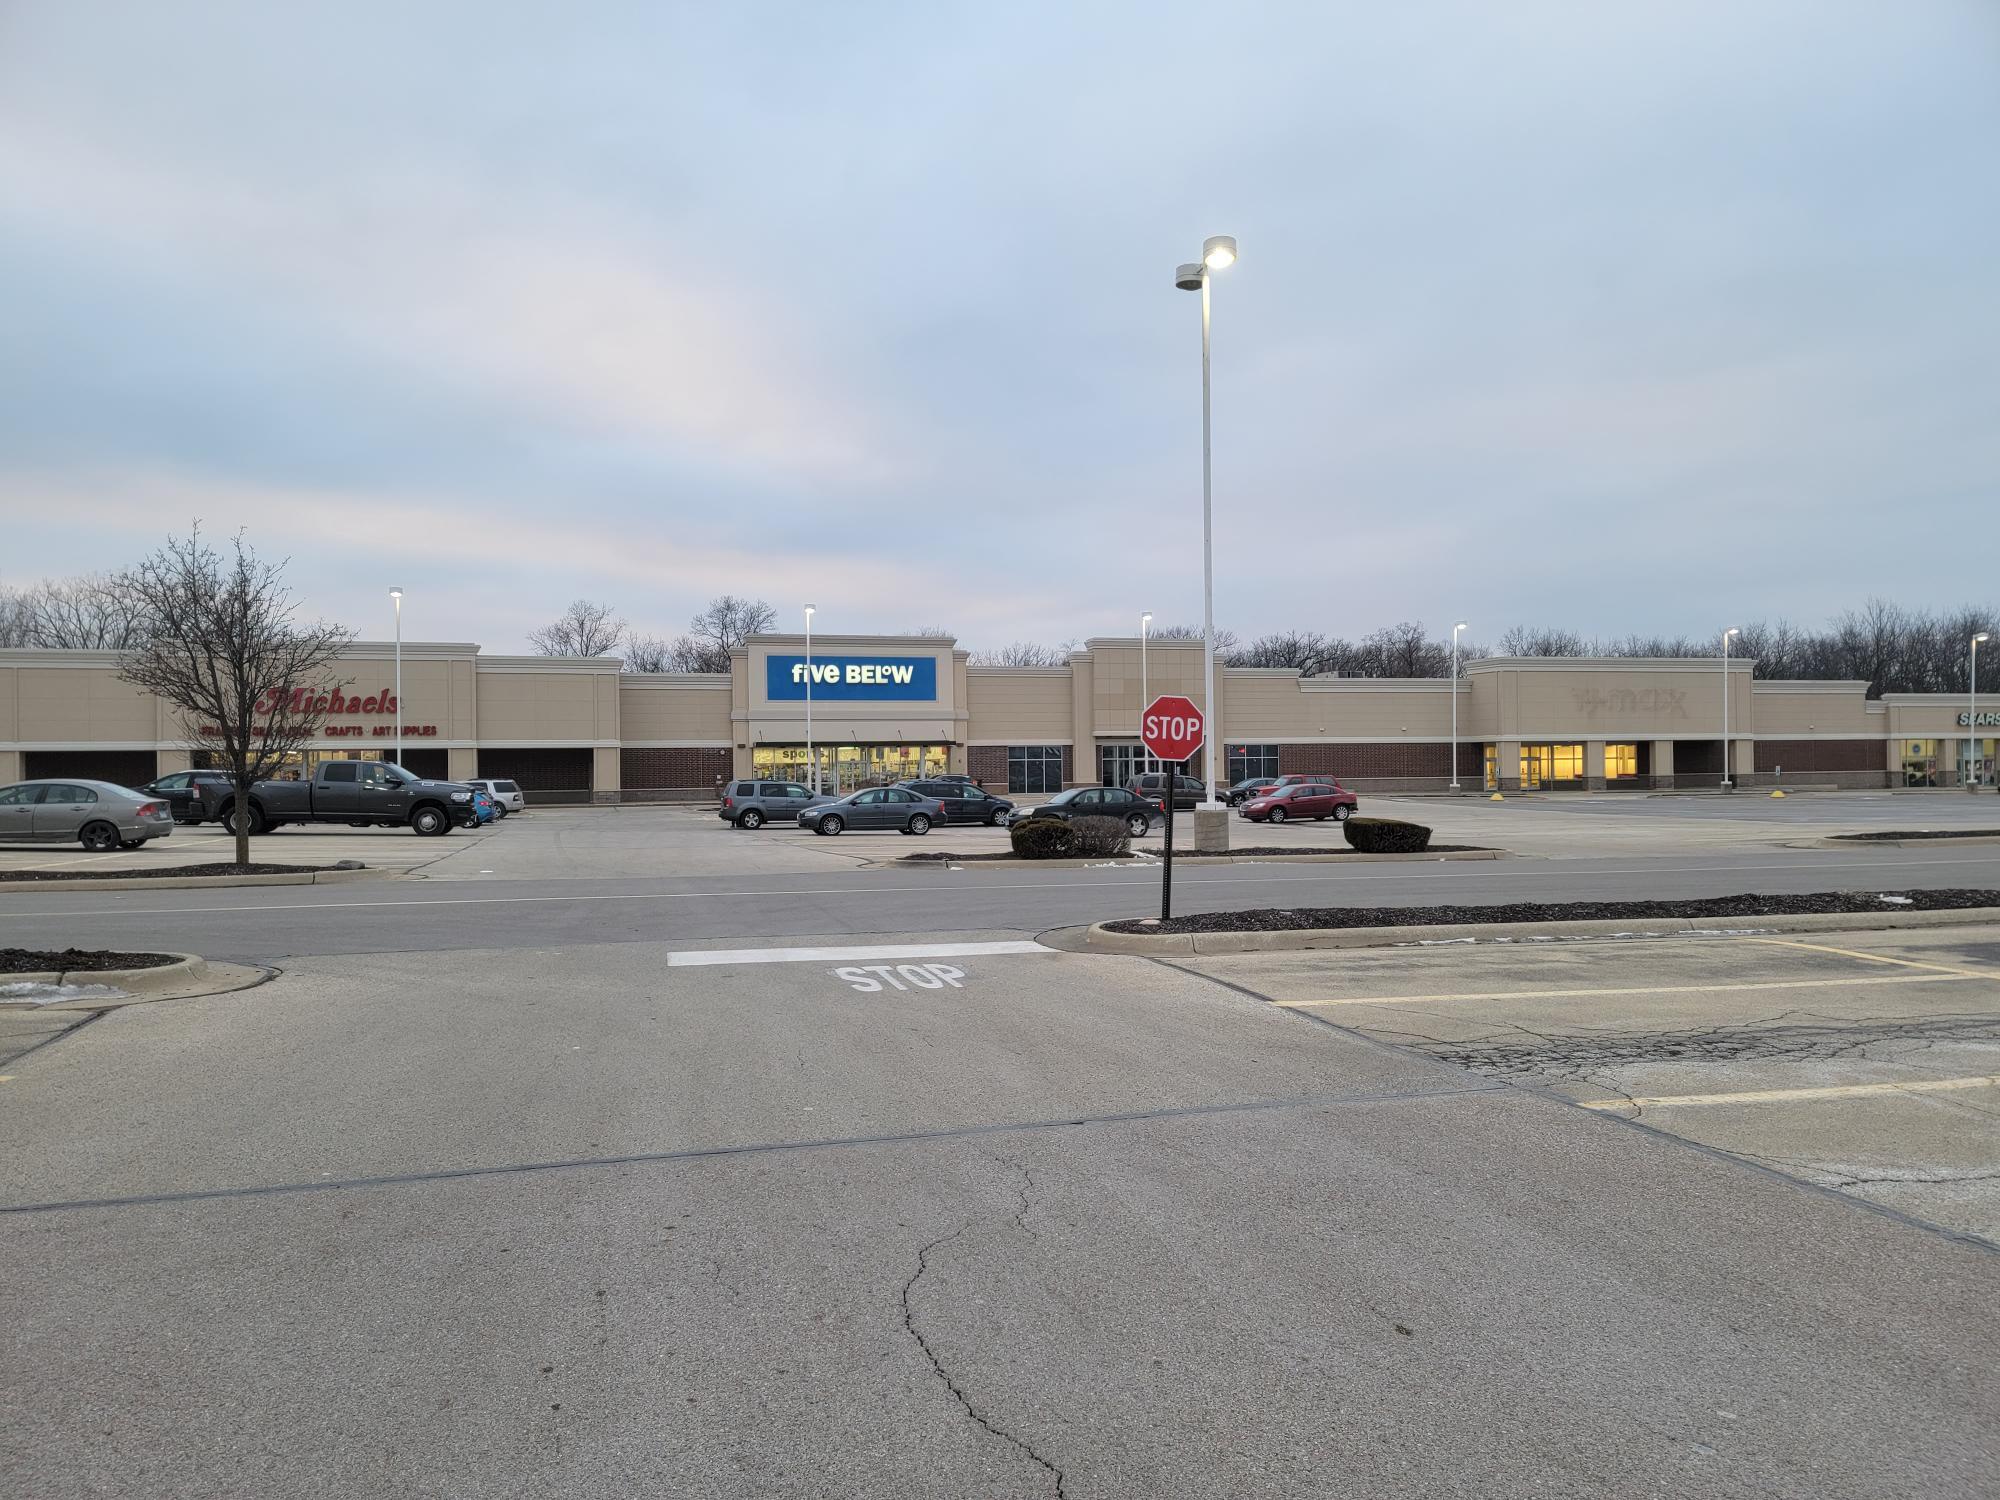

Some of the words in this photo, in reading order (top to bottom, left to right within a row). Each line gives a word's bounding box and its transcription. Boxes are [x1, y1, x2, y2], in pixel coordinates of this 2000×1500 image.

[792, 664, 840, 683] five
[255, 687, 402, 716] Michaels
[1146, 715, 1200, 741] STOP
[1958, 712, 2000, 727] SEARS
[325, 726, 363, 736] CRAFTS
[372, 726, 392, 736] ART
[835, 964, 965, 992] STOP
